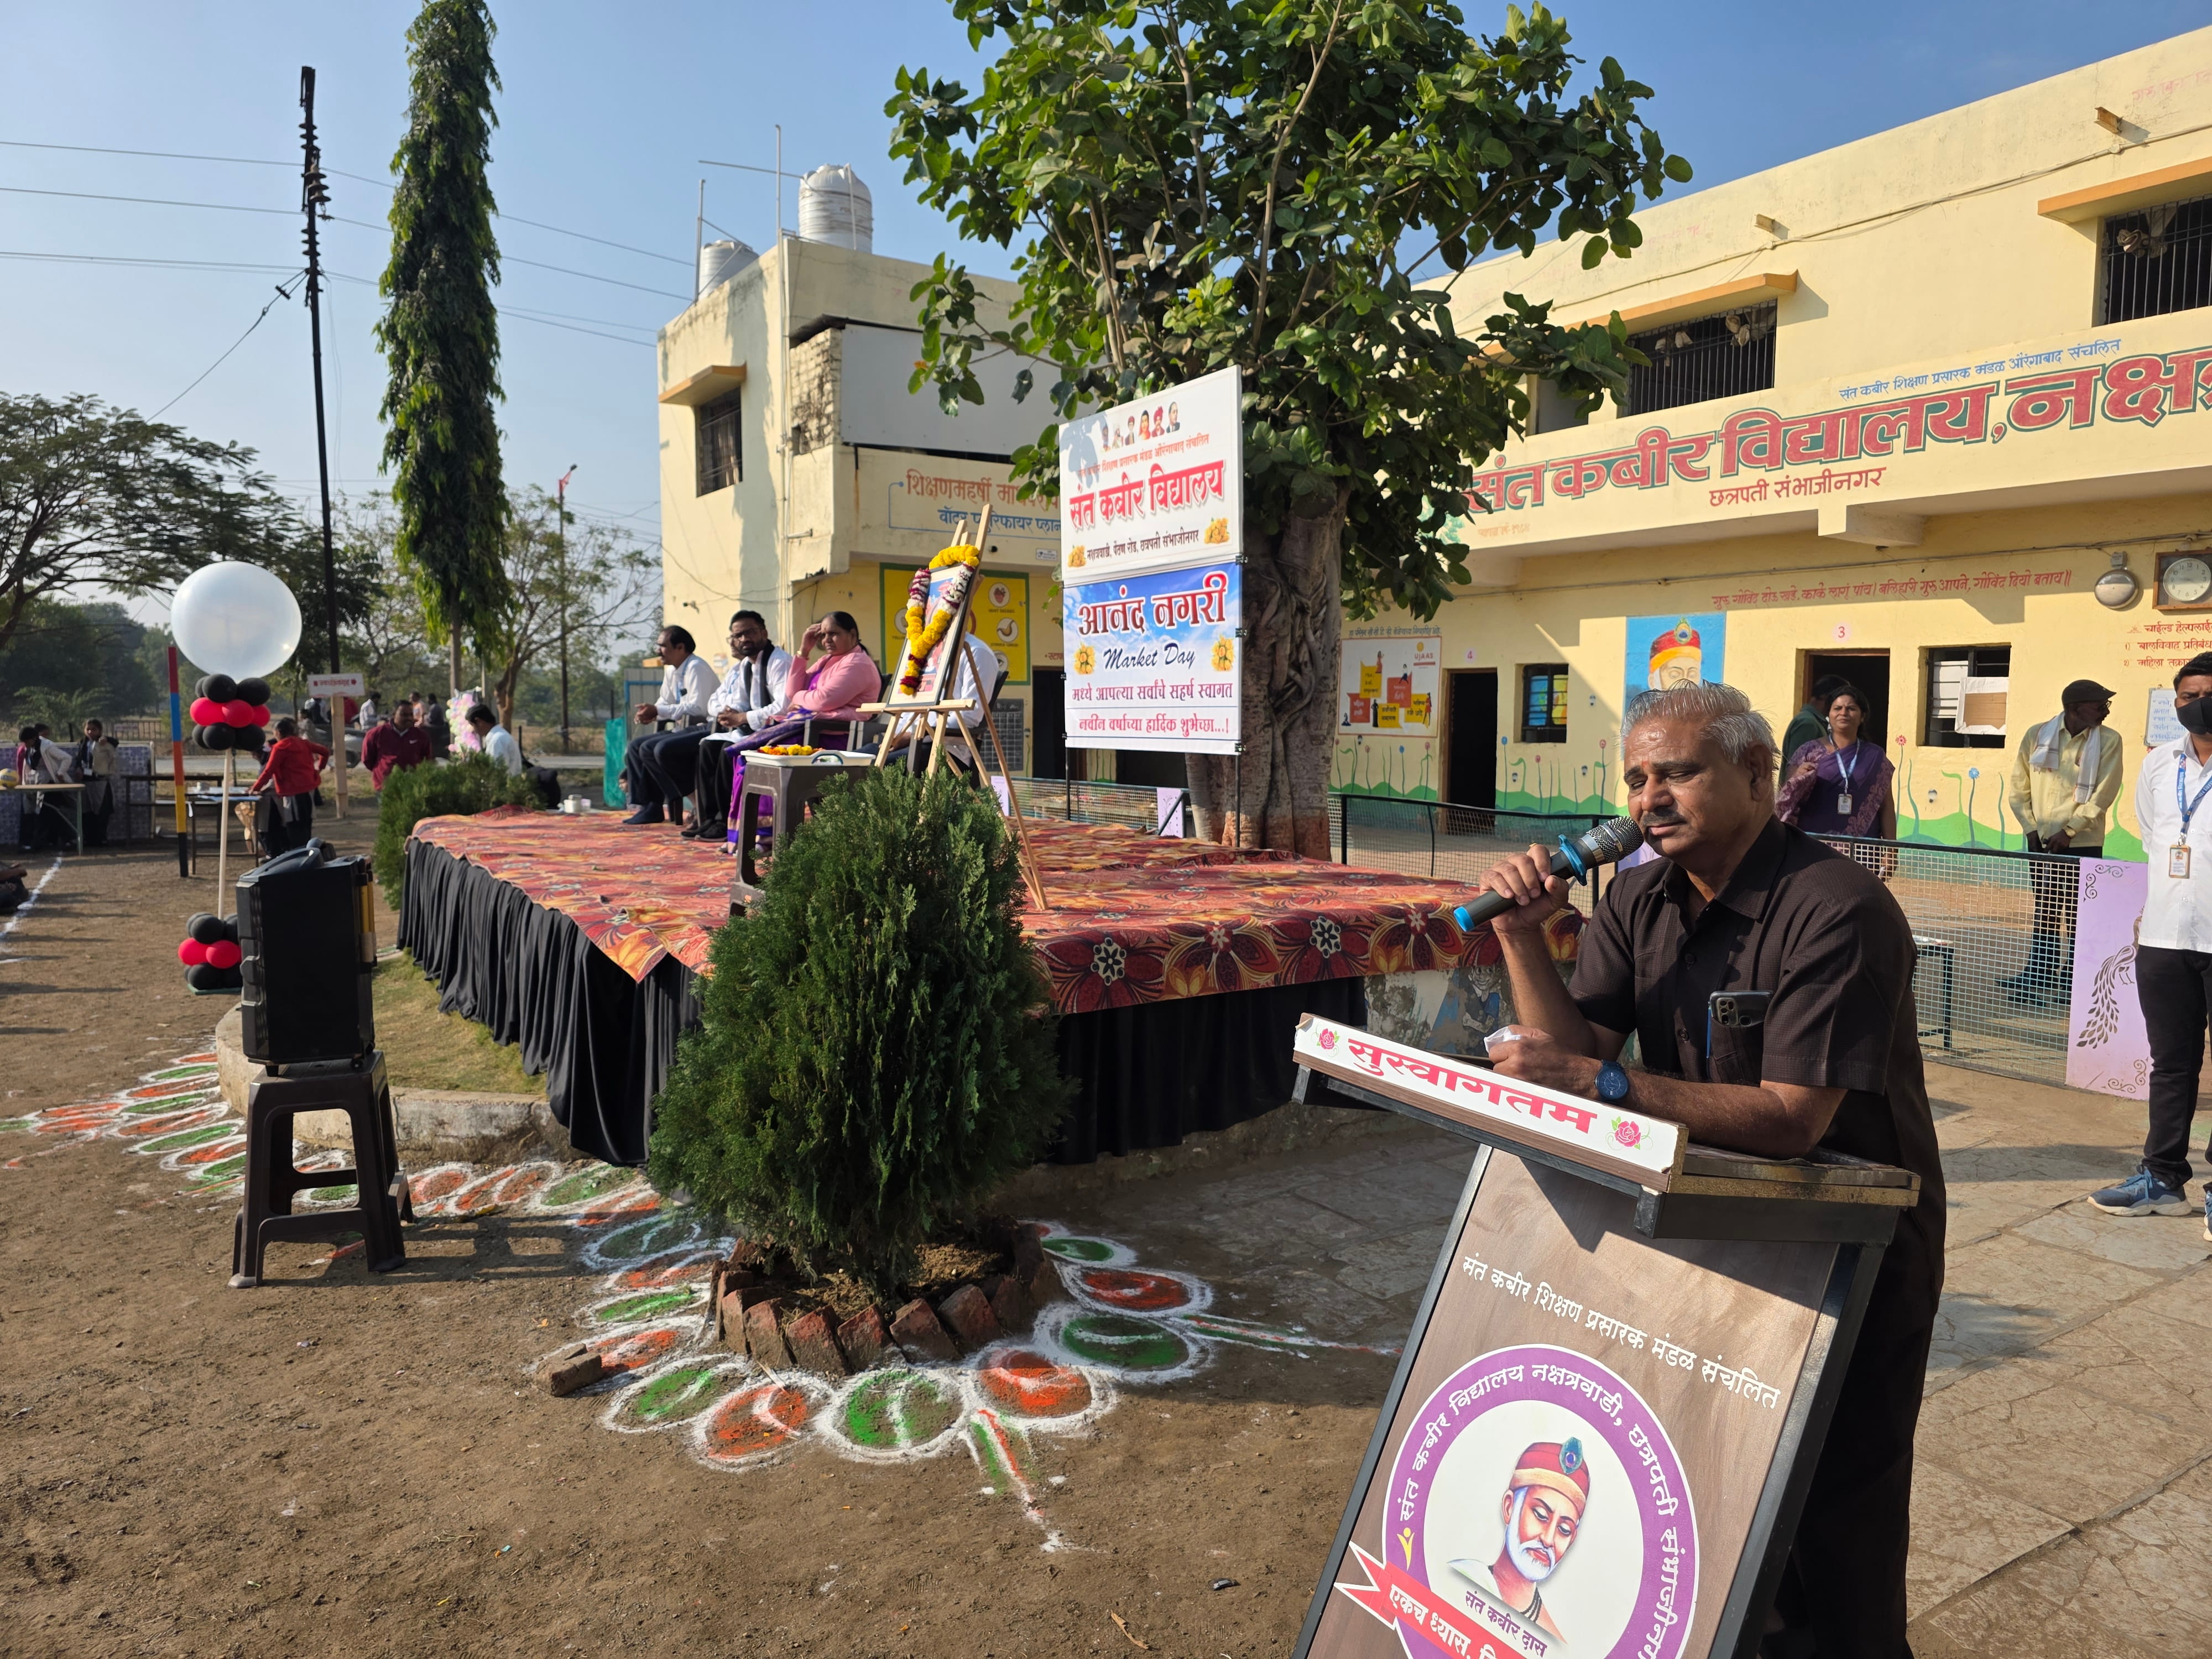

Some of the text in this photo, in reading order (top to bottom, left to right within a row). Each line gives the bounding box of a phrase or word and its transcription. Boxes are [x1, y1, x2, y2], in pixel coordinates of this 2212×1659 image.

[1839, 339, 2121, 401] संत कबीर शिक्षण प्रसारक मंडळ औरंगाबाद संचलित
[1461, 455, 1547, 513] संत
[1548, 426, 1717, 499] कबीर
[2005, 346, 2212, 428] नक्ष
[1102, 459, 1118, 471] शिक्षण
[1119, 453, 1138, 467] प्रसारक
[1140, 448, 1152, 461] मंडळ
[906, 469, 992, 503] शिक्षणमहर्षी
[1070, 460, 1224, 529] संत कबीर विद्यालय
[1709, 467, 1887, 507] छत्रपती संभाजीनगर
[937, 505, 968, 524] वॉटर
[1127, 538, 1139, 553] रोड,
[1140, 531, 1160, 551] छत्रपती
[1162, 526, 1199, 547] संभाजीनगर
[1802, 582, 1825, 599] काके
[1973, 572, 2007, 592] गोविंद
[2008, 569, 2032, 589] दियो
[1078, 573, 1227, 635] आनंद नगरी
[1838, 626, 1845, 638] 3
[2144, 619, 2212, 634] चाईल्ड हेल्पलाई
[1103, 643, 1195, 669] Market Day
[1415, 653, 1433, 661] UJAAS
[1468, 651, 1473, 659] 4
[2137, 639, 2180, 653] बालविवाह
[2137, 656, 2163, 669] महिला
[1072, 678, 1233, 701] मध्ये आपल्या सर्वांचे सहर्ष स्वागत
[1079, 714, 1105, 731] नवीन
[1109, 713, 1142, 731] वर्षाच्या
[1146, 713, 1177, 733] हार्दिक
[1348, 1039, 1597, 1134] सुस्वागतम
[1463, 1253, 1781, 1409] संत कबीर शिक्षण प्रसारक मंडळ संचलित
[1397, 1364, 1686, 1659] संत कबीर विद्यालय नक्षत्रवाडी, छत्रपती संभाजीनग
[1390, 1584, 1429, 1625] एकच
[1465, 1590, 1486, 1615] संत
[1487, 1613, 1520, 1641] कबीर
[1522, 1630, 1547, 1658] दास
